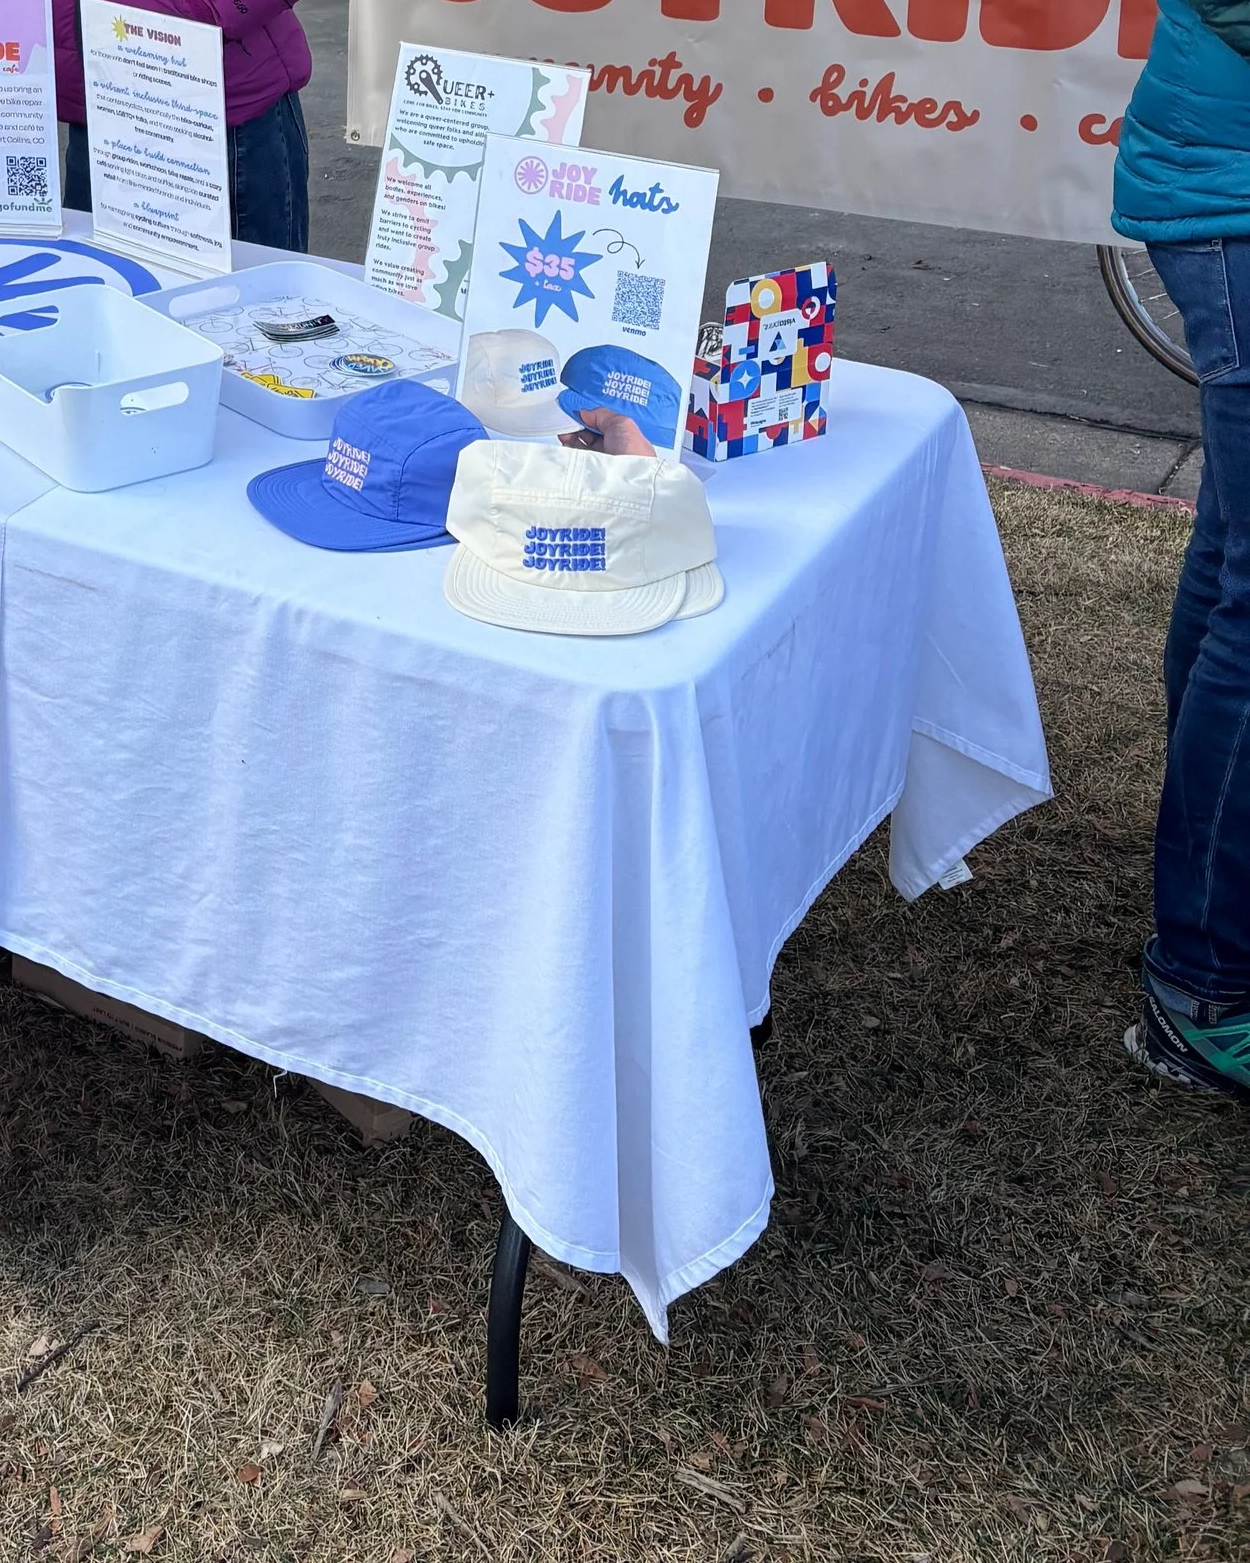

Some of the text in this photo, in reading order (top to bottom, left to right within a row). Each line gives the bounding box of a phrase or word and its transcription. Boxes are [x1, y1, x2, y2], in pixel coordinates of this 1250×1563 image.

[124, 23, 182, 46] THE VISION
[125, 45, 169, 66] welcoming
[13, 85, 31, 94] bring
[132, 89, 170, 107] inclusive
[810, 63, 980, 132] bikes
[22, 99, 43, 107] repair
[444, 96, 486, 111] BIKES
[0, 111, 44, 120] community
[396, 118, 427, 129] welcoming
[428, 123, 445, 132] queer
[446, 126, 461, 134] folks
[462, 129, 473, 137] and
[419, 130, 452, 141] committed
[459, 137, 485, 147] upholdin
[111, 139, 132, 153] place
[134, 144, 142, 156] to
[144, 147, 166, 162] build
[166, 156, 210, 176] connection
[551, 162, 598, 184] JOY
[397, 179, 423, 189] welcome
[549, 180, 602, 206] RIDE
[395, 196, 418, 205] genders
[608, 174, 679, 214] hats
[141, 201, 180, 222] blueprint
[379, 218, 401, 227] barriers
[410, 225, 432, 235] cycling
[377, 234, 435, 253] truly inclusive group
[384, 262, 399, 270] value
[400, 266, 424, 276] creating
[524, 245, 576, 282] $35
[371, 267, 403, 280] community
[371, 275, 387, 284] much
[404, 283, 418, 291] love
[622, 326, 646, 337] venmo
[605, 379, 650, 398] JOYRIDE!
[607, 370, 652, 389] JOYRIDE!
[602, 388, 648, 406] JOYRIDE!
[525, 525, 606, 542] JOYRIDE!
[523, 541, 606, 557] JOYRIDE!
[522, 556, 607, 572] JOYRIDE!
[1148, 996, 1188, 1053] SALOMON
